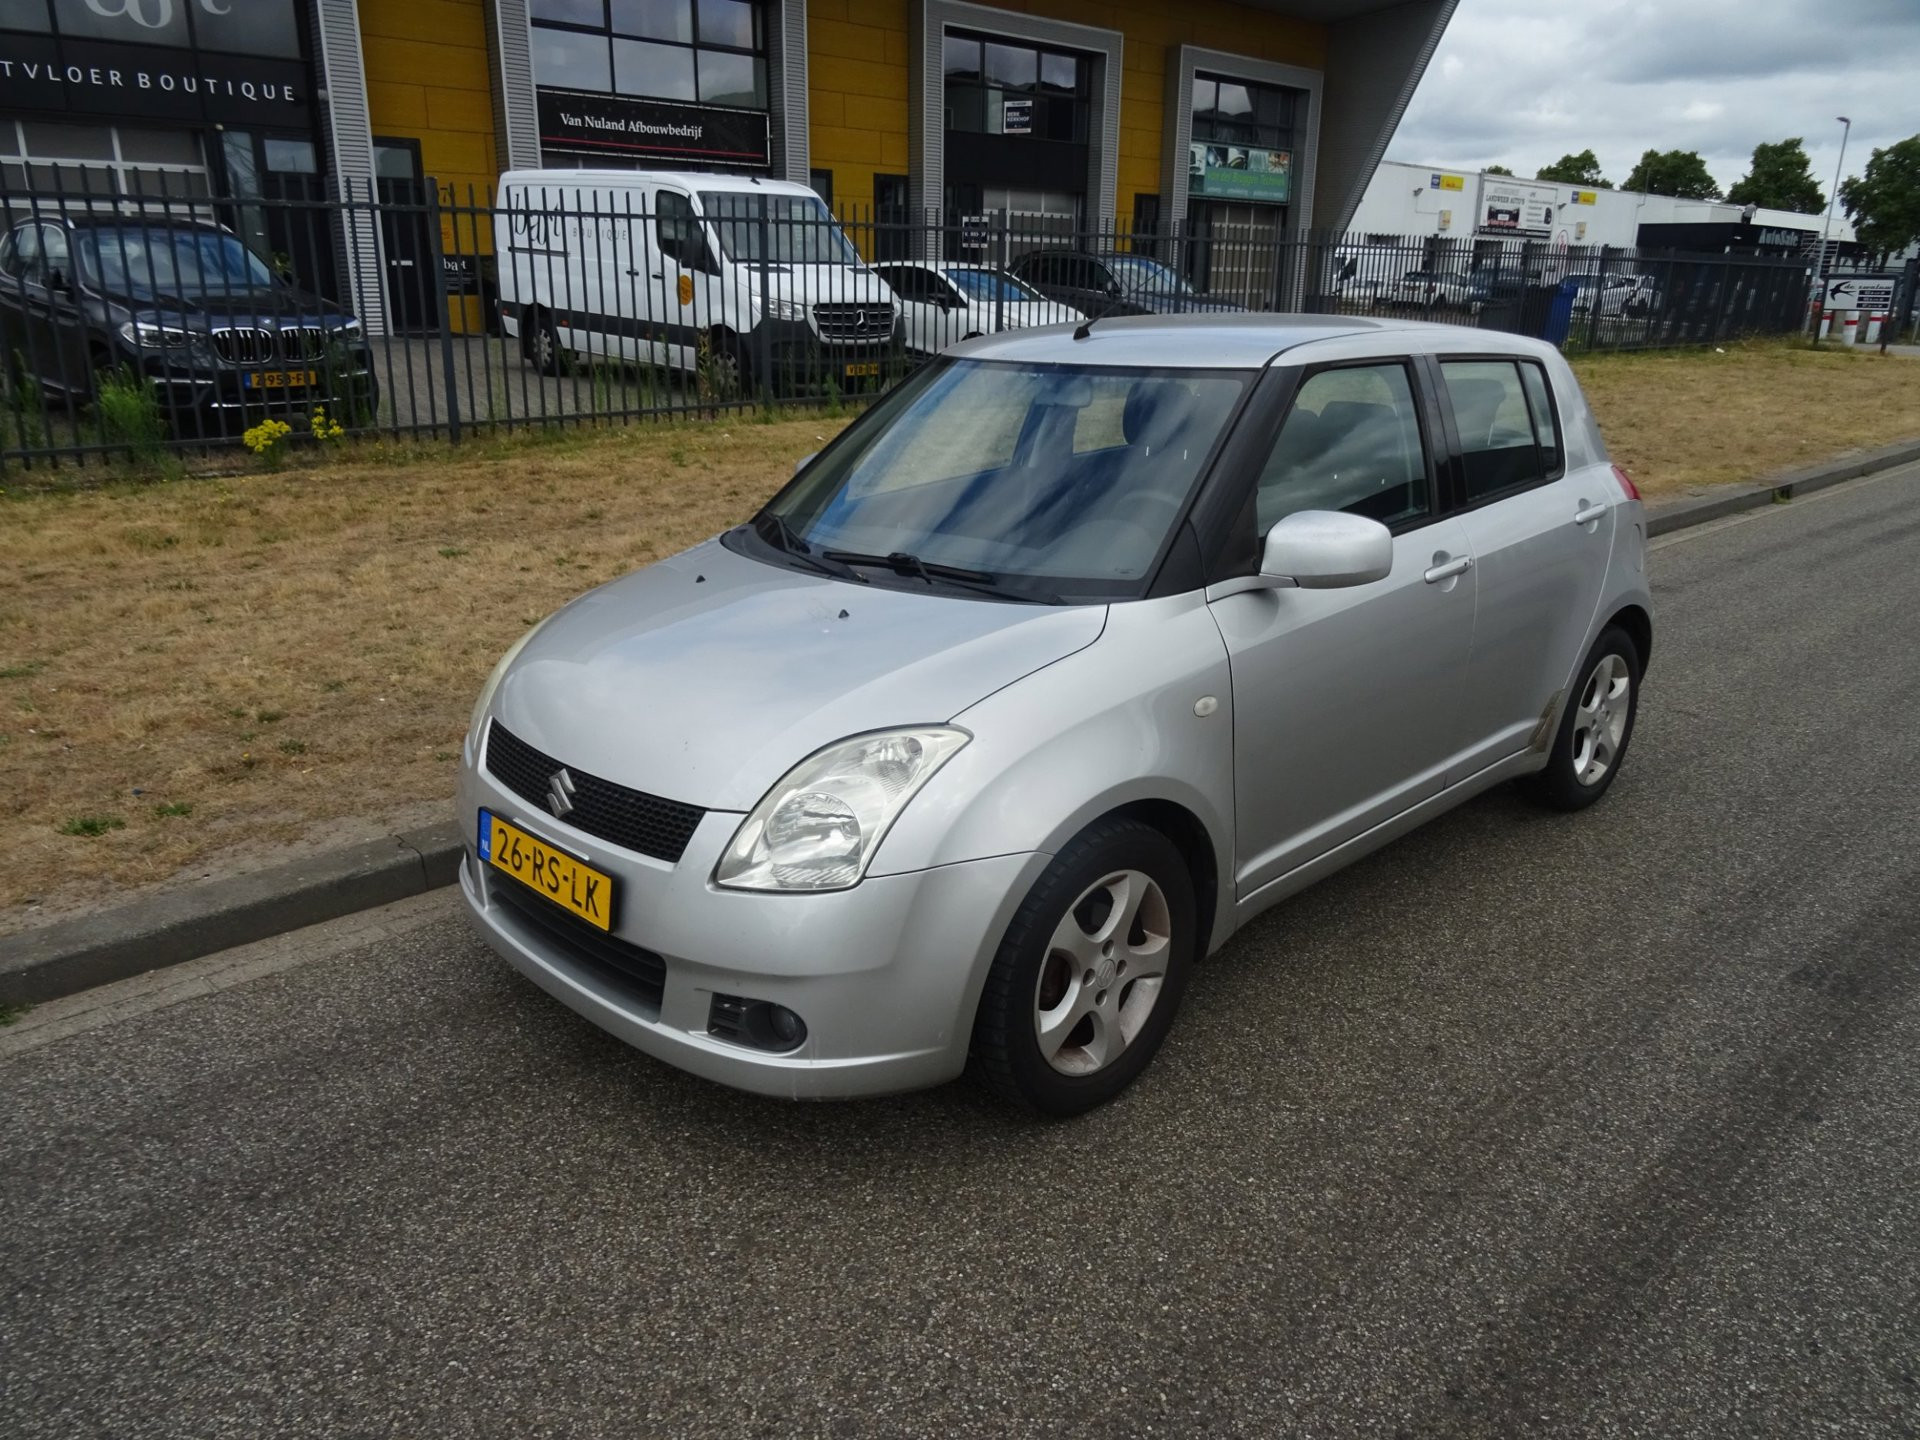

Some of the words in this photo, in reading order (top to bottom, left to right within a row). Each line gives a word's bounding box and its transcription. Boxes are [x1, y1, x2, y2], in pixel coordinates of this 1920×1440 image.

[137, 72, 295, 101] BOUTIQUE
[560, 113, 582, 127] Van
[584, 115, 625, 131] Nuland
[627, 120, 702, 140] Afbouwbedrijf
[498, 827, 599, 919] 26-RS-LK
